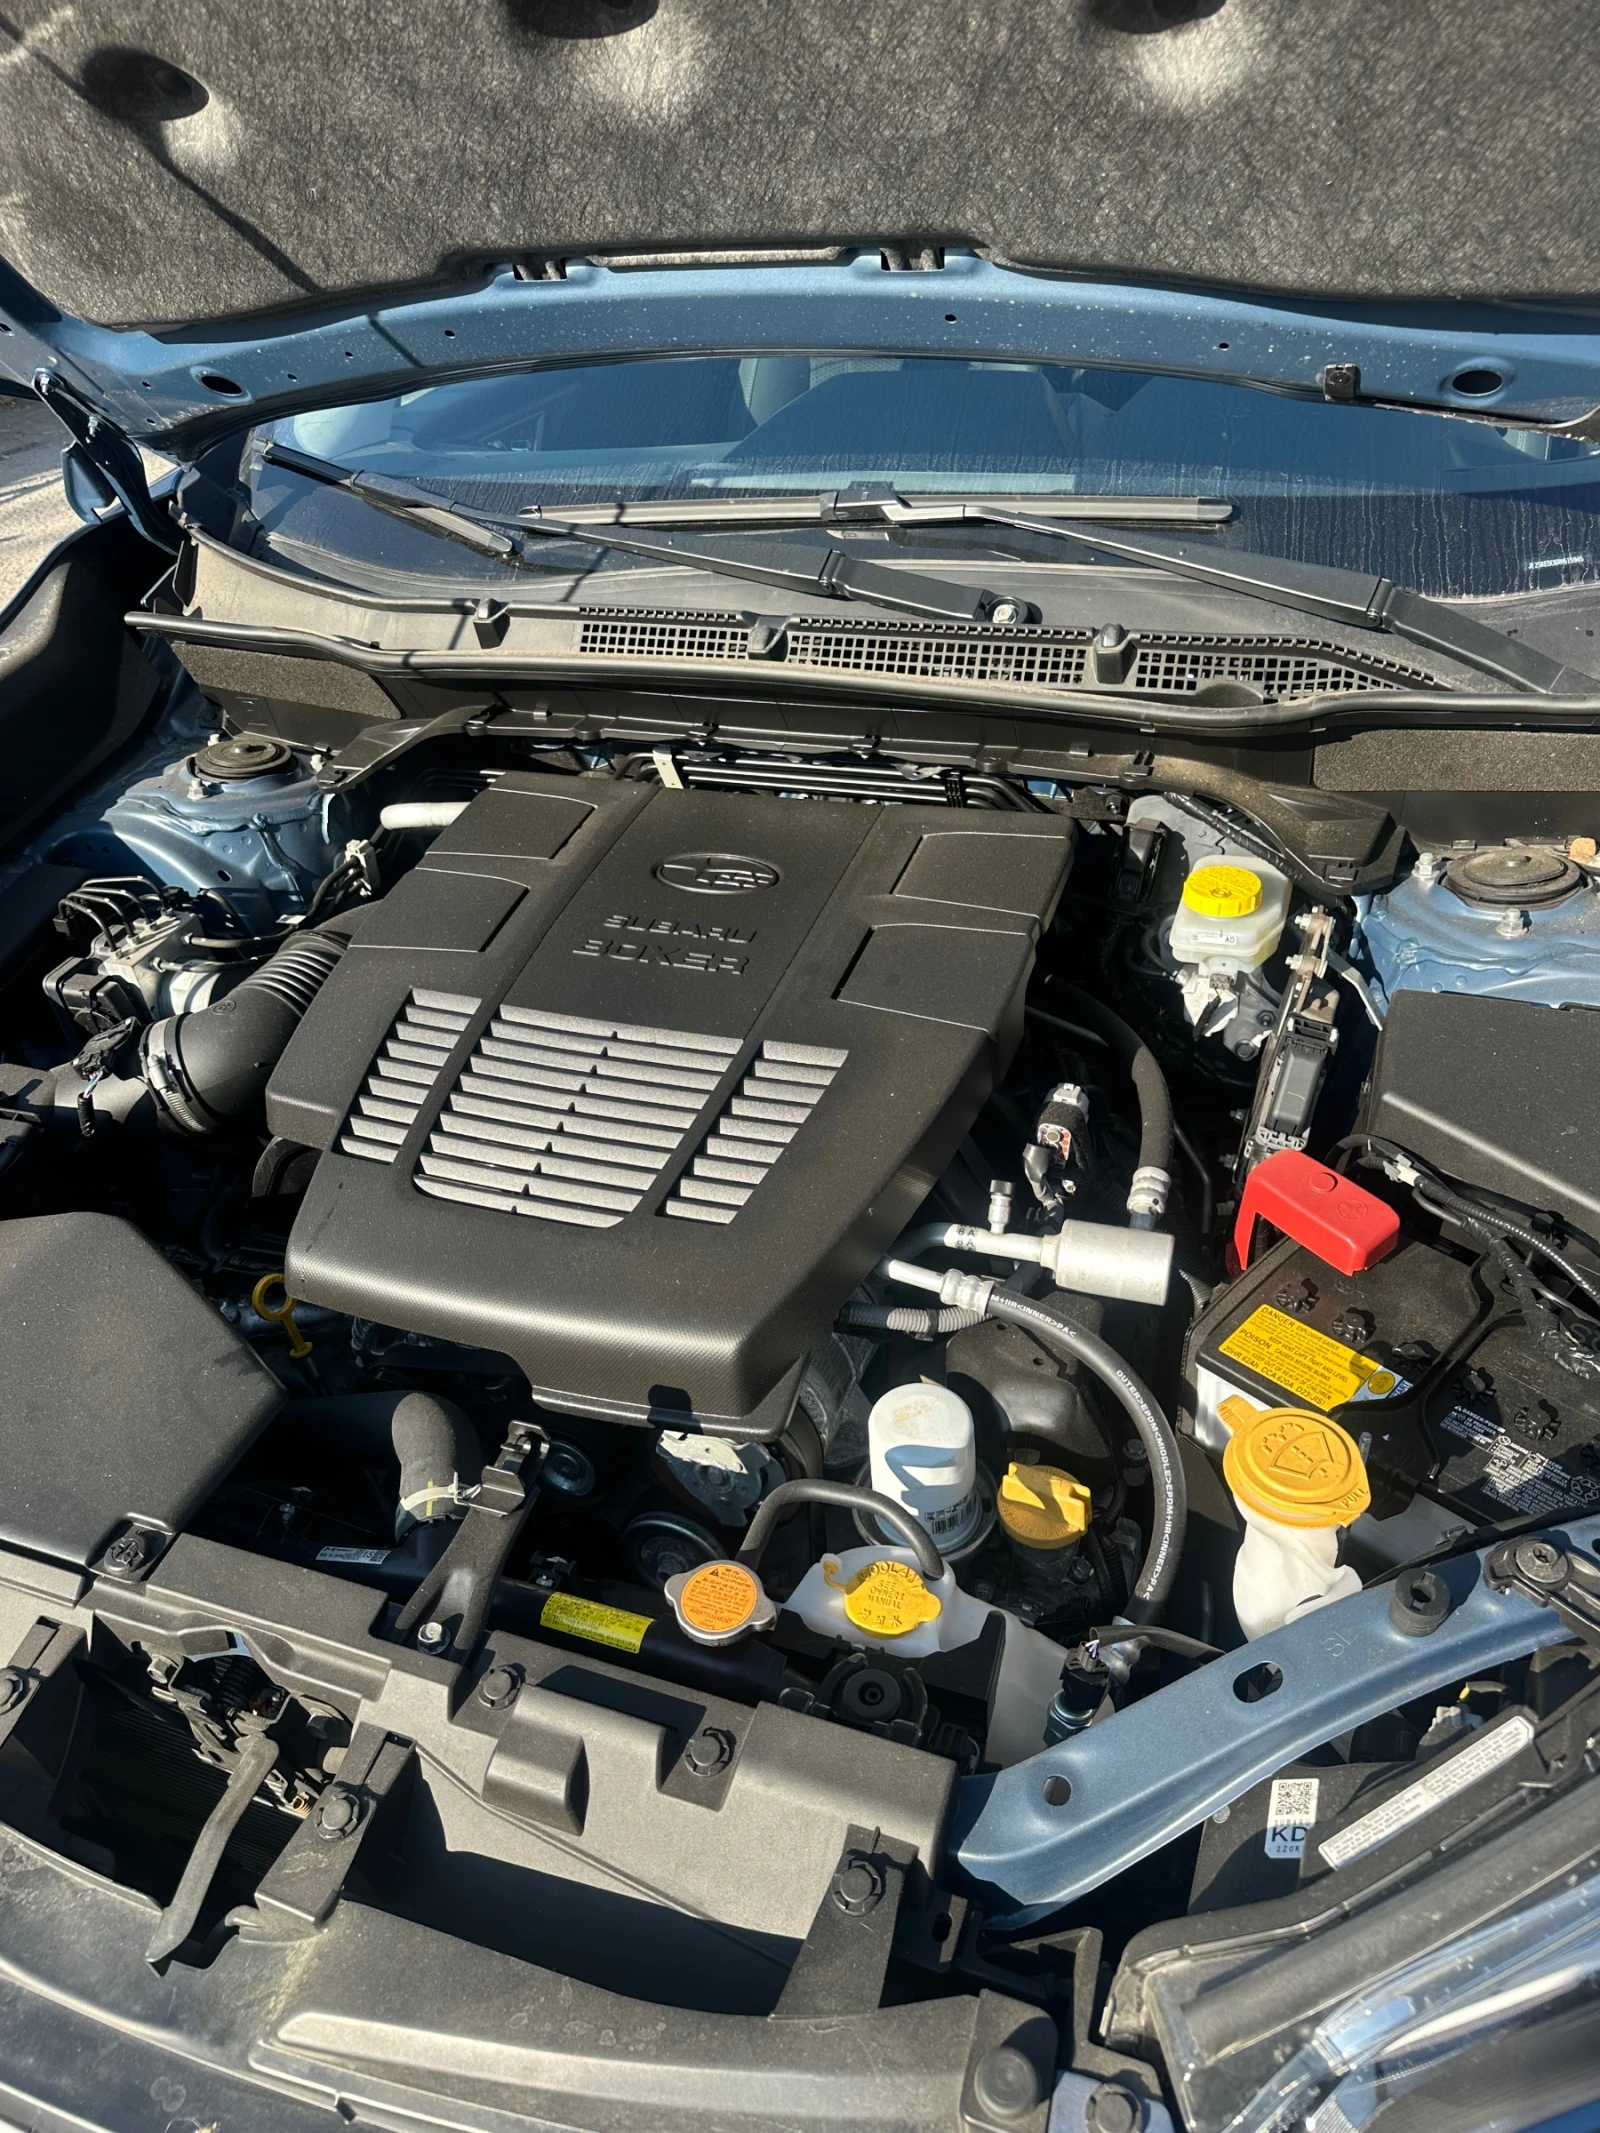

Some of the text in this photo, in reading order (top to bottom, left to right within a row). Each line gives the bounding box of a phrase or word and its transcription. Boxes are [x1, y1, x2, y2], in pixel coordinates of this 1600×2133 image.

[603, 914, 757, 944] SUBARU
[572, 939, 749, 976] BOXER
[1261, 1306, 1340, 1351] DANGER EXPLOSIVE GASES
[1223, 1345, 1243, 1359] 20HR
[1241, 1355, 1259, 1369] 62Ah
[1260, 1366, 1277, 1379] CCA
[1276, 1376, 1294, 1388] 620A
[1239, 1328, 1331, 1381] POISON CAUSES SEVERE BURNS
[1269, 1336, 1349, 1383] KEEP VENT CAPS TIGHT AND LEVEL
[1251, 1353, 1332, 1400] KEEP OUT OF REACH OF CHILDREN
[1340, 1488, 1368, 1509] PULL
[858, 1561, 925, 1591] COOLANT
[877, 1579, 897, 1591] SEE
[868, 1594, 902, 1609] MANUAL
[1271, 1826, 1308, 1842] KD
